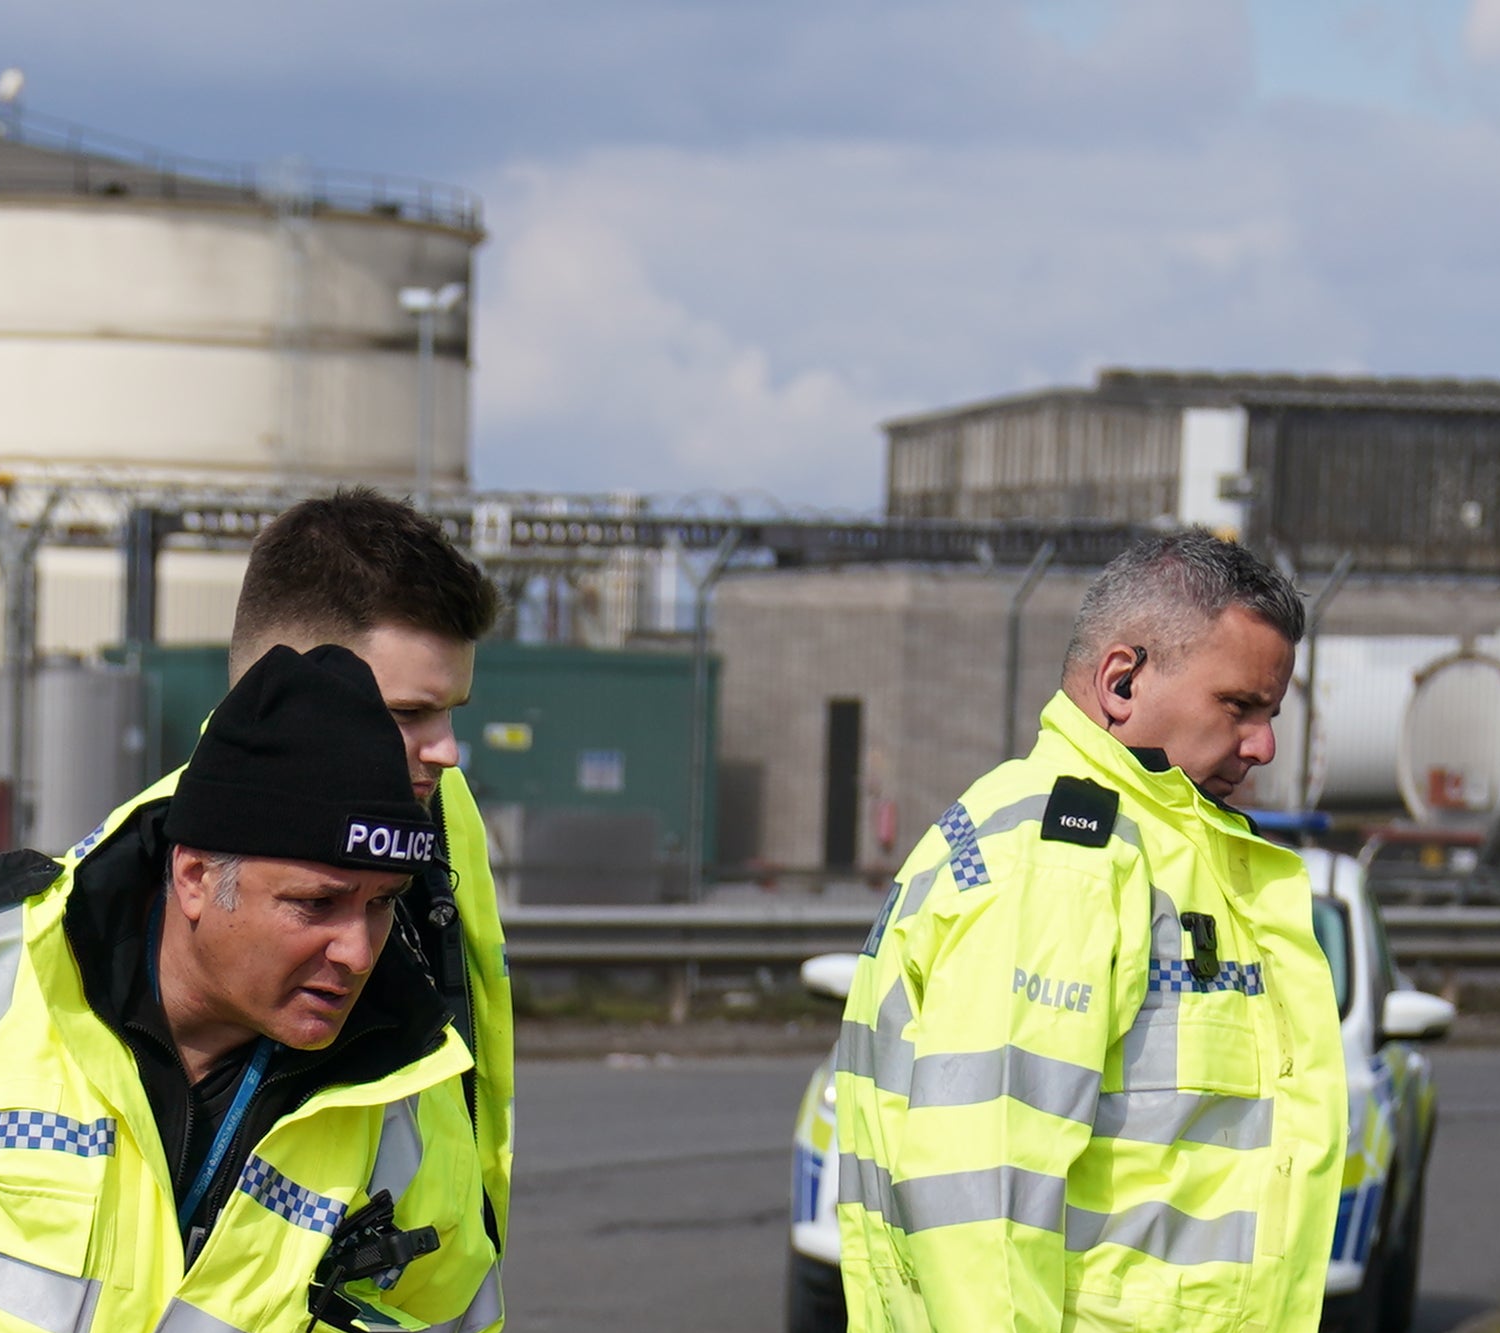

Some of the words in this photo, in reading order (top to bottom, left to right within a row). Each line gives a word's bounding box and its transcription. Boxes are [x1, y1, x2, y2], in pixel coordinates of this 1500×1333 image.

[346, 823, 435, 862] POLICE
[1059, 814, 1098, 832] 1634
[1012, 967, 1093, 1014] POLICE
